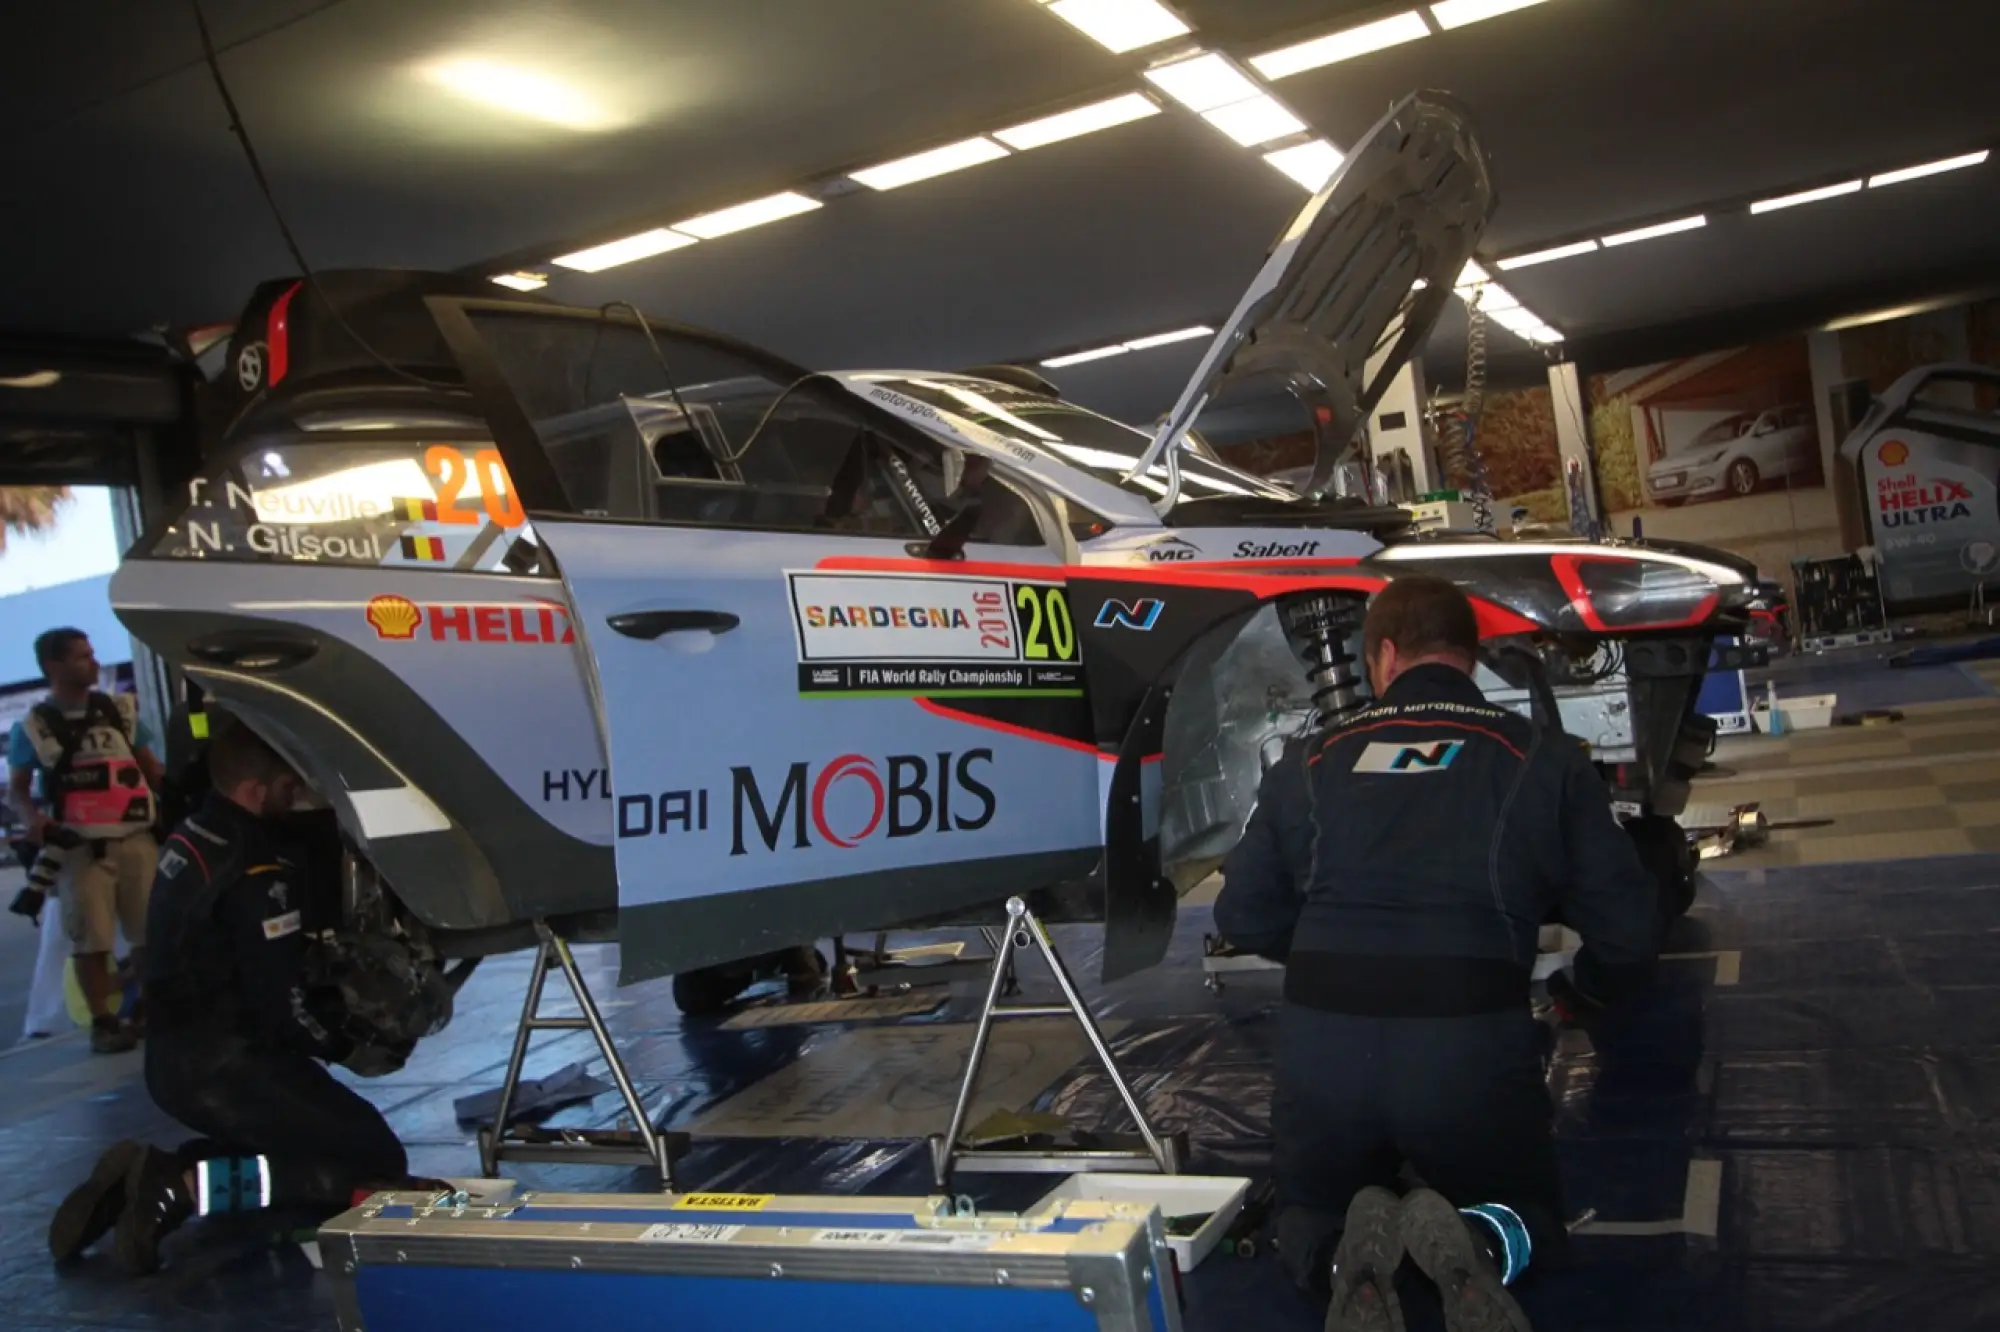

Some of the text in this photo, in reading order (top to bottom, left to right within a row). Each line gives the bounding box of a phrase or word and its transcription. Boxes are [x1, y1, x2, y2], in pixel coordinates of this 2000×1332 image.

[425, 443, 526, 528] 20
[1878, 472, 1916, 493] Shell
[1879, 479, 1973, 512] HELIX
[1881, 502, 1971, 529] ULTRA
[188, 520, 381, 560] N. Gilsoul
[1232, 540, 1321, 559] Sabelt
[805, 590, 1011, 649] SARDEGNA 2016
[1016, 585, 1075, 661] 20
[859, 669, 1023, 687] FIA World Rally Championship
[1403, 702, 1507, 719] MOTORSPORT
[617, 788, 708, 839] DAI
[729, 747, 997, 857] MOBIS
